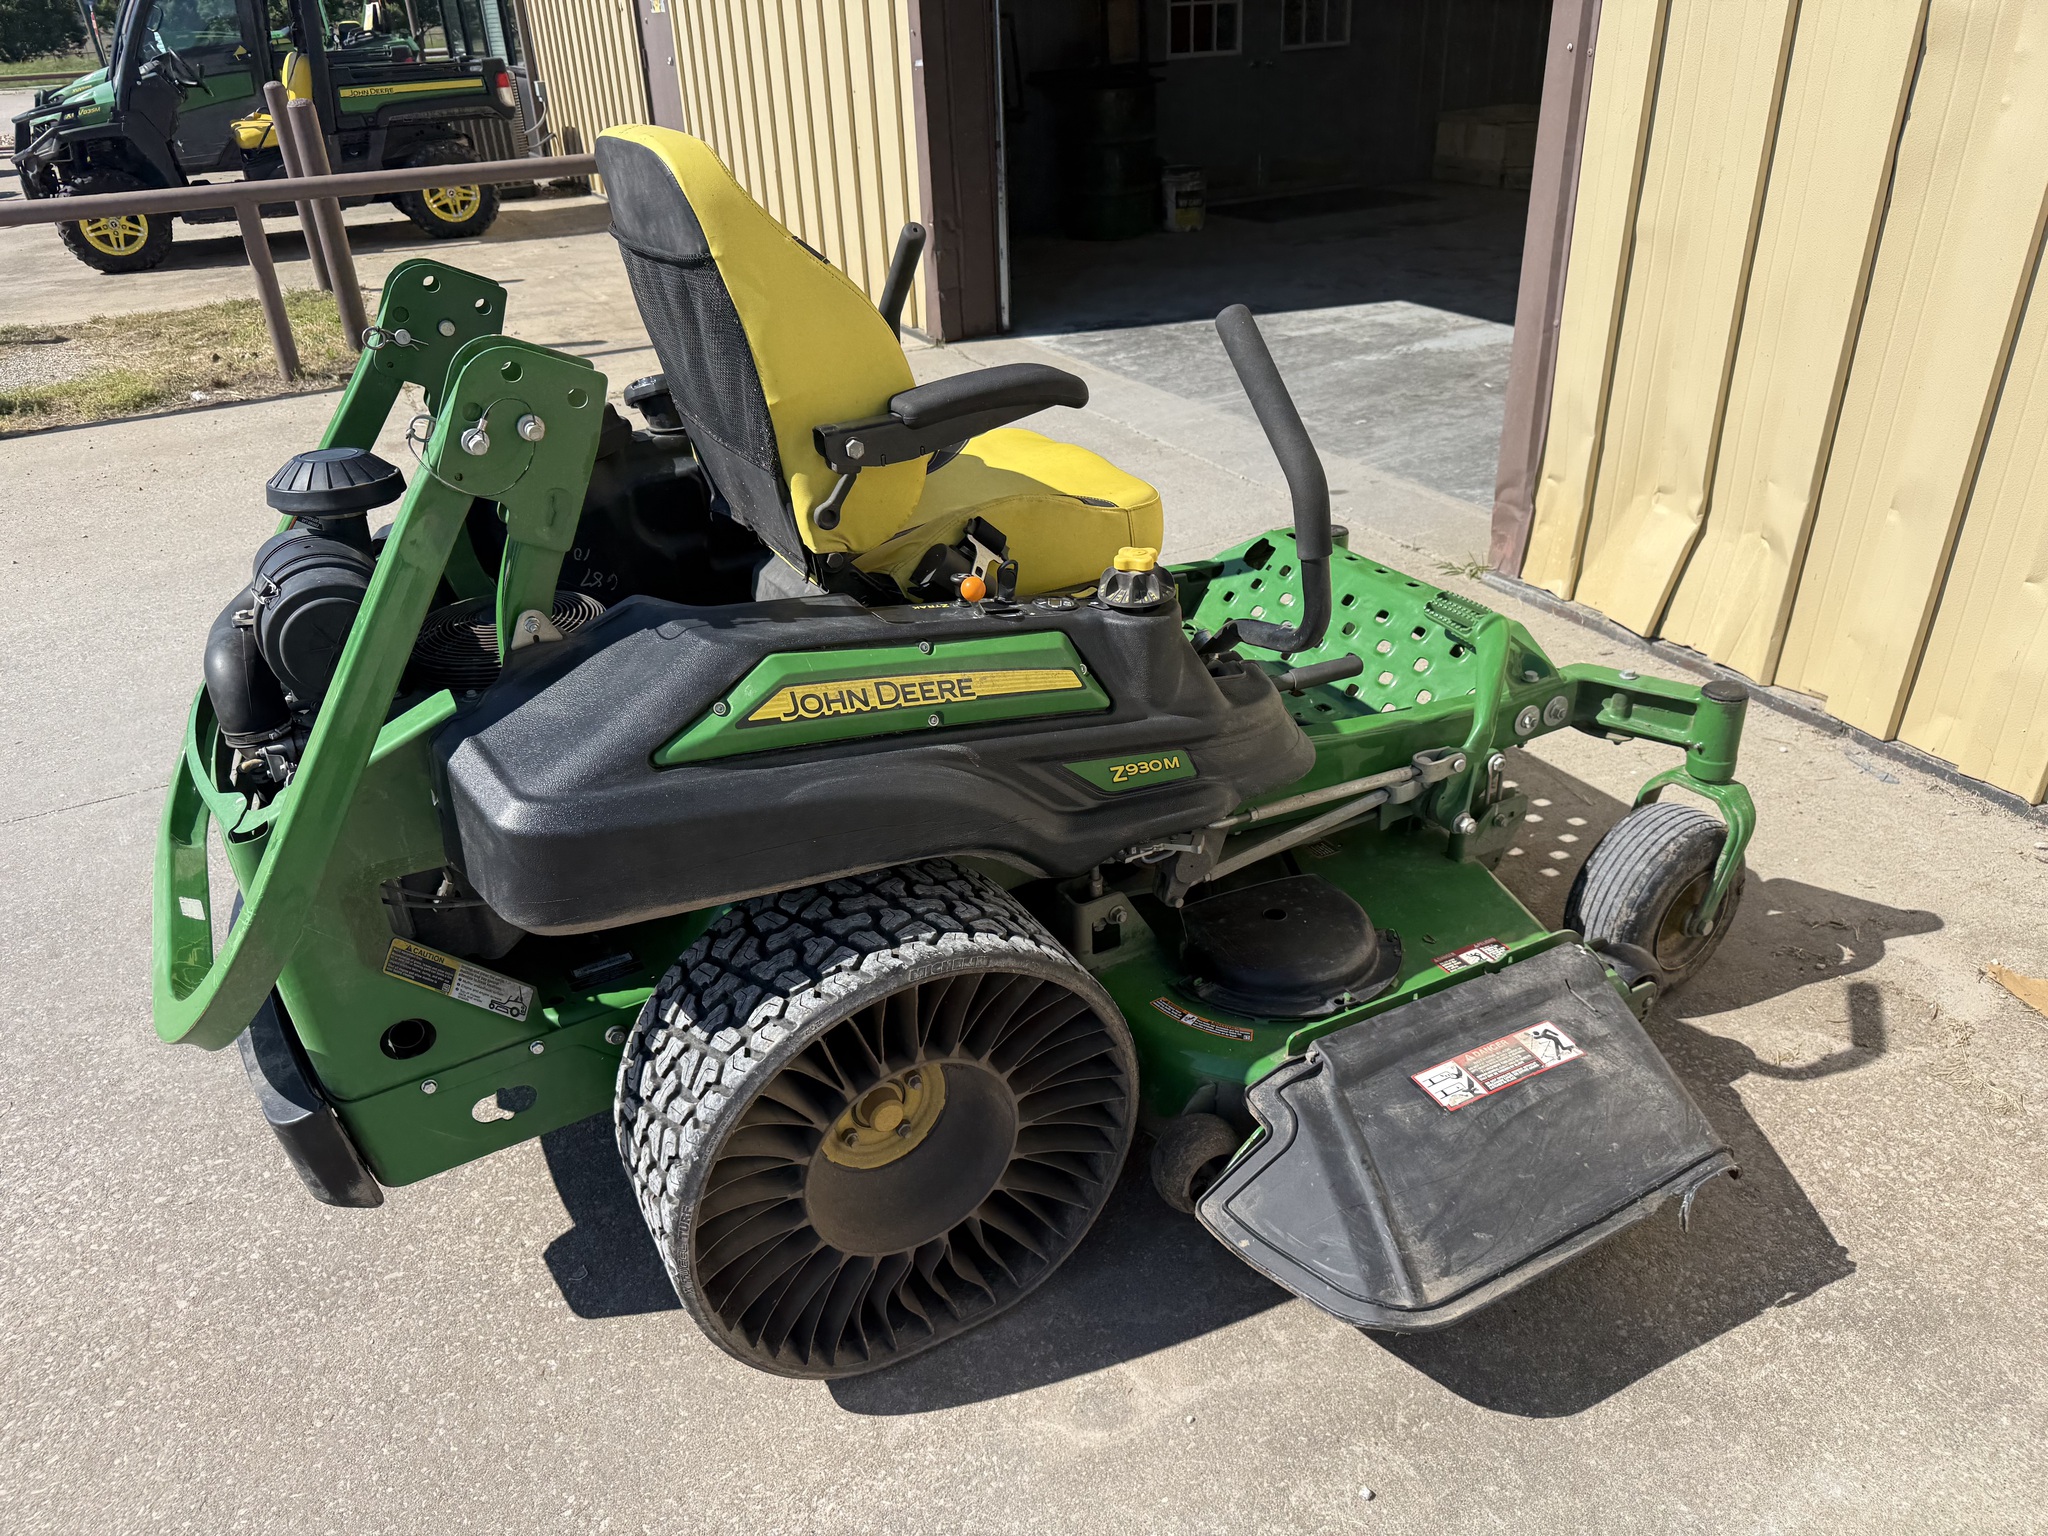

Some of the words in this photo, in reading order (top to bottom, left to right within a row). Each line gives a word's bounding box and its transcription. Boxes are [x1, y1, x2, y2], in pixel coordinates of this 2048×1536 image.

[370, 87, 394, 95] DEERE
[783, 688, 871, 718] JOHN
[874, 677, 976, 706] DEERE
[1109, 756, 1180, 783] Z930M
[413, 947, 445, 964] CAUTION
[908, 956, 989, 981] MICHELIN
[1471, 1039, 1509, 1057] DANGER
[678, 1205, 692, 1239] TURF
